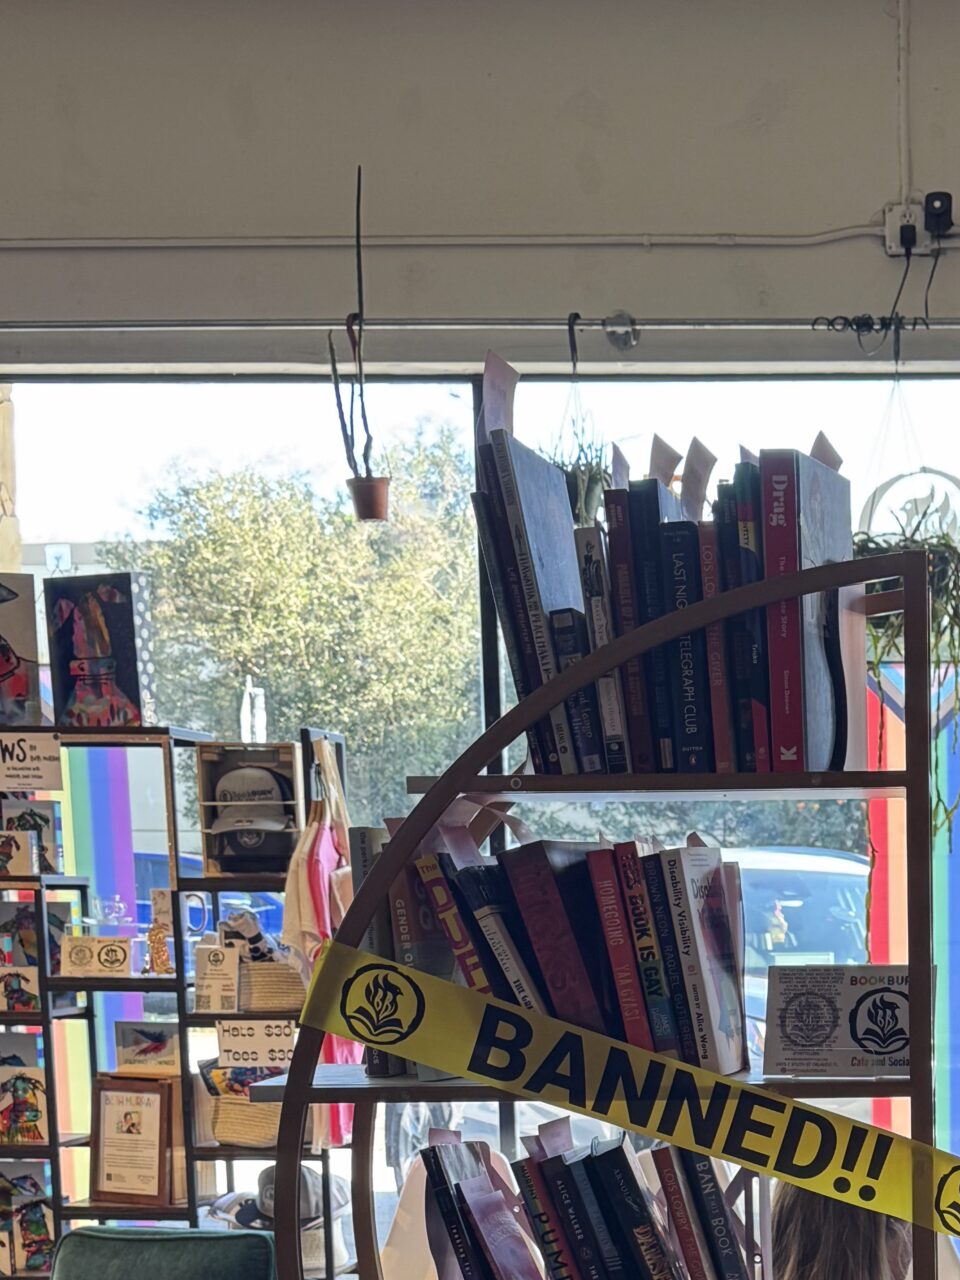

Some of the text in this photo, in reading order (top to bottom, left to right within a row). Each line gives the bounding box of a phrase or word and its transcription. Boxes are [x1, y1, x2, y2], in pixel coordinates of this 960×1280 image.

[671, 552, 685, 580] LAST
[673, 585, 687, 609] NIG
[702, 544, 722, 686] LOIS GIVER
[678, 635, 695, 701] TELEGRAPH
[683, 704, 697, 734] CLUB
[394, 898, 410, 949] GENDER
[664, 857, 694, 957] Disability Visibility
[592, 878, 640, 1022] HOMEGOING YAA GYASI
[625, 892, 664, 1000] BOOK IS GAY
[850, 975, 909, 986] BOOKBUR
[222, 1024, 292, 1038] Hats $30
[694, 1010, 710, 1060] Alice Wong
[888, 1056, 910, 1067] Socia
[467, 1003, 894, 1203] BANNED!!
[610, 1166, 634, 1203] ARNOLD
[662, 1167, 678, 1192] LOIS
[670, 1193, 690, 1231] LOWRY
[683, 1236, 697, 1258] THE
[696, 1160, 716, 1199] BAN
[709, 1215, 734, 1258] BOOK
[555, 1177, 572, 1205] ALICE
[565, 1206, 584, 1241] WALKER
[587, 1264, 599, 1280] THE
